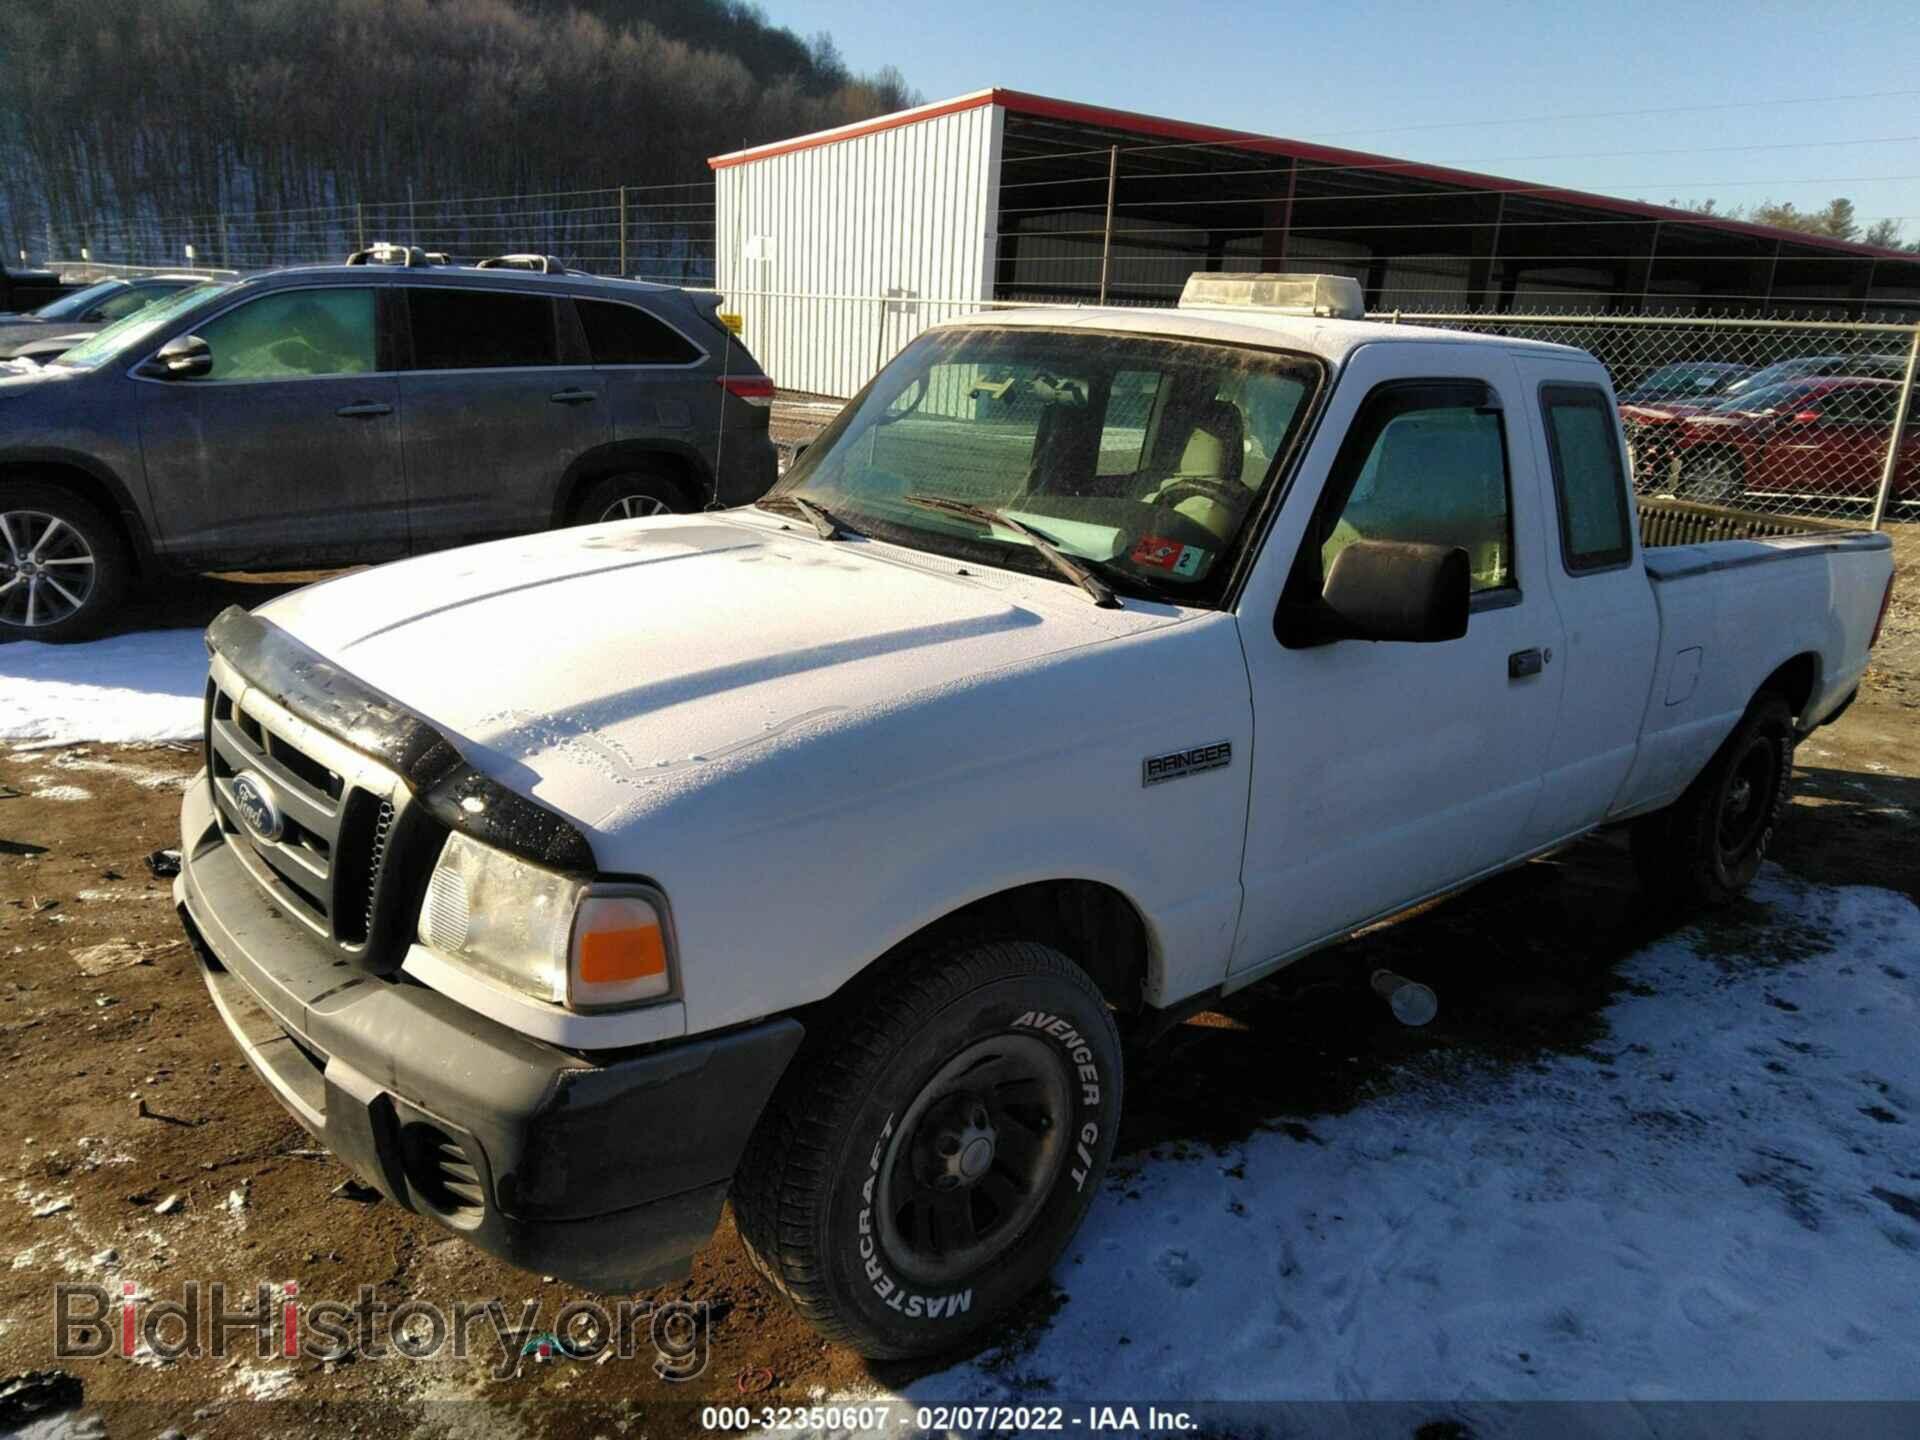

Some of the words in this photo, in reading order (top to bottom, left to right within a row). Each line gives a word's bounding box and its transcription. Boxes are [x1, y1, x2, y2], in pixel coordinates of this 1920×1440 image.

[238, 783, 264, 829] Ford
[1147, 741, 1232, 777] RANGER
[1010, 1011, 1099, 1106] AVENGER
[1071, 1122, 1098, 1192] G/T
[859, 1112, 972, 1318] MASTERCRAFT
